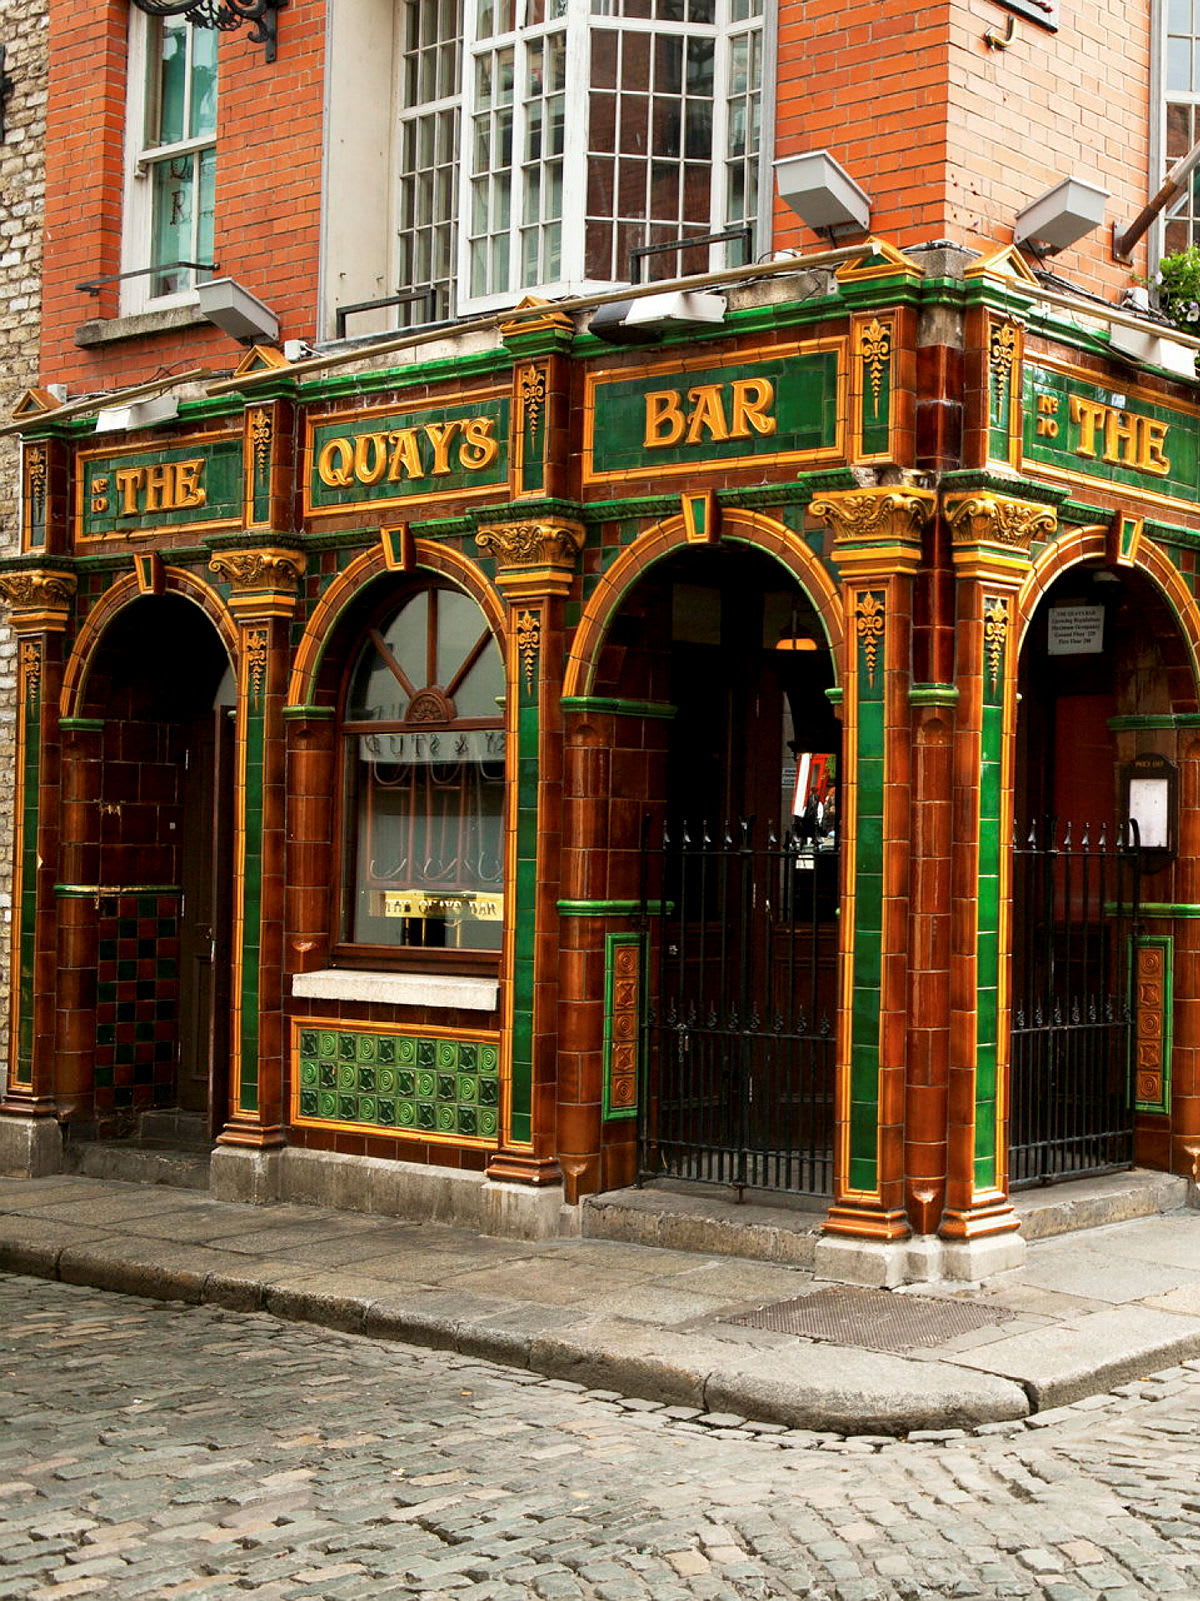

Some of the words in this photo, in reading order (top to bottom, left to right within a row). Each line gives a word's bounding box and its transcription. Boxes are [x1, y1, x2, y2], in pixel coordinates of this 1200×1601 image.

[643, 377, 776, 449] BAR
[1037, 415, 1059, 438] 10
[1069, 393, 1170, 478] THE
[116, 458, 207, 516] THE
